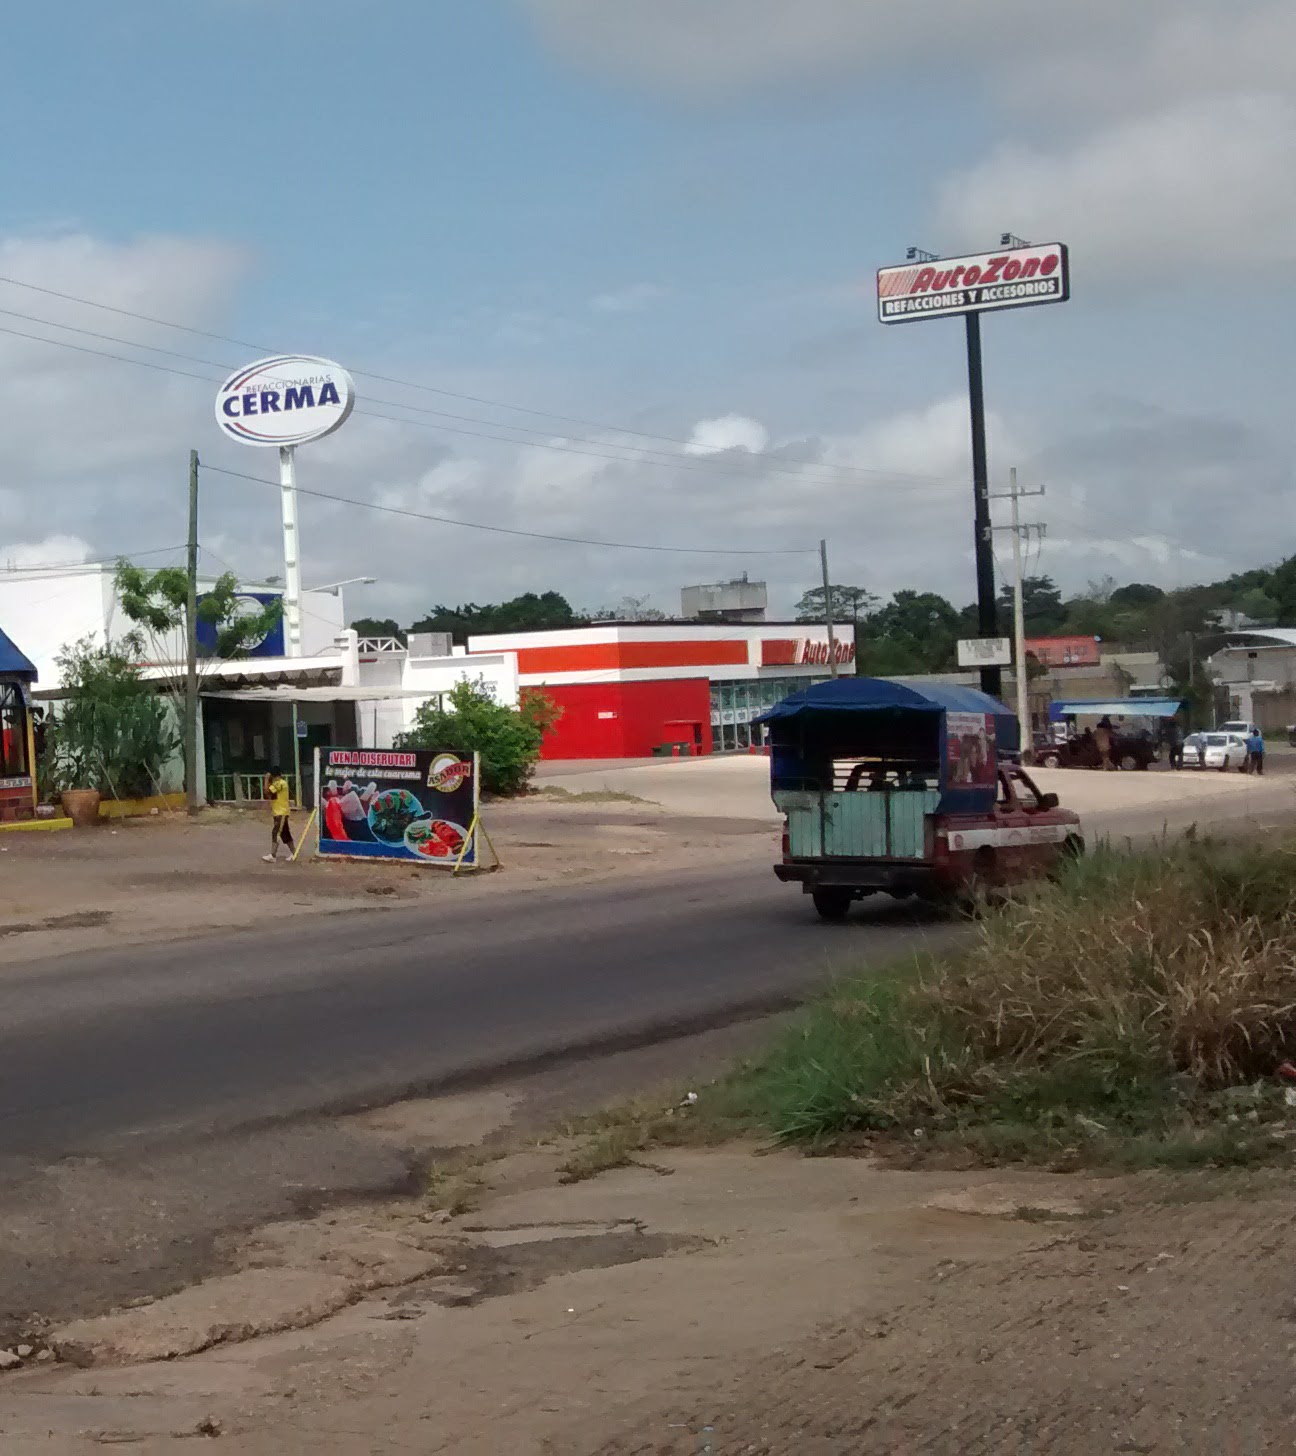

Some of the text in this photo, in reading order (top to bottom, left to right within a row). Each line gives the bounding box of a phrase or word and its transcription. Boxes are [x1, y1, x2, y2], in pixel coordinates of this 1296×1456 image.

[909, 253, 1059, 294] AutoZone
[885, 279, 1056, 314] REFACCIONES Y ACCESORIOS
[222, 382, 341, 418] CERMA
[246, 374, 333, 394] REFACCIONARIAS
[351, 752, 360, 766] A
[360, 752, 416, 767] DISFRUTAR!
